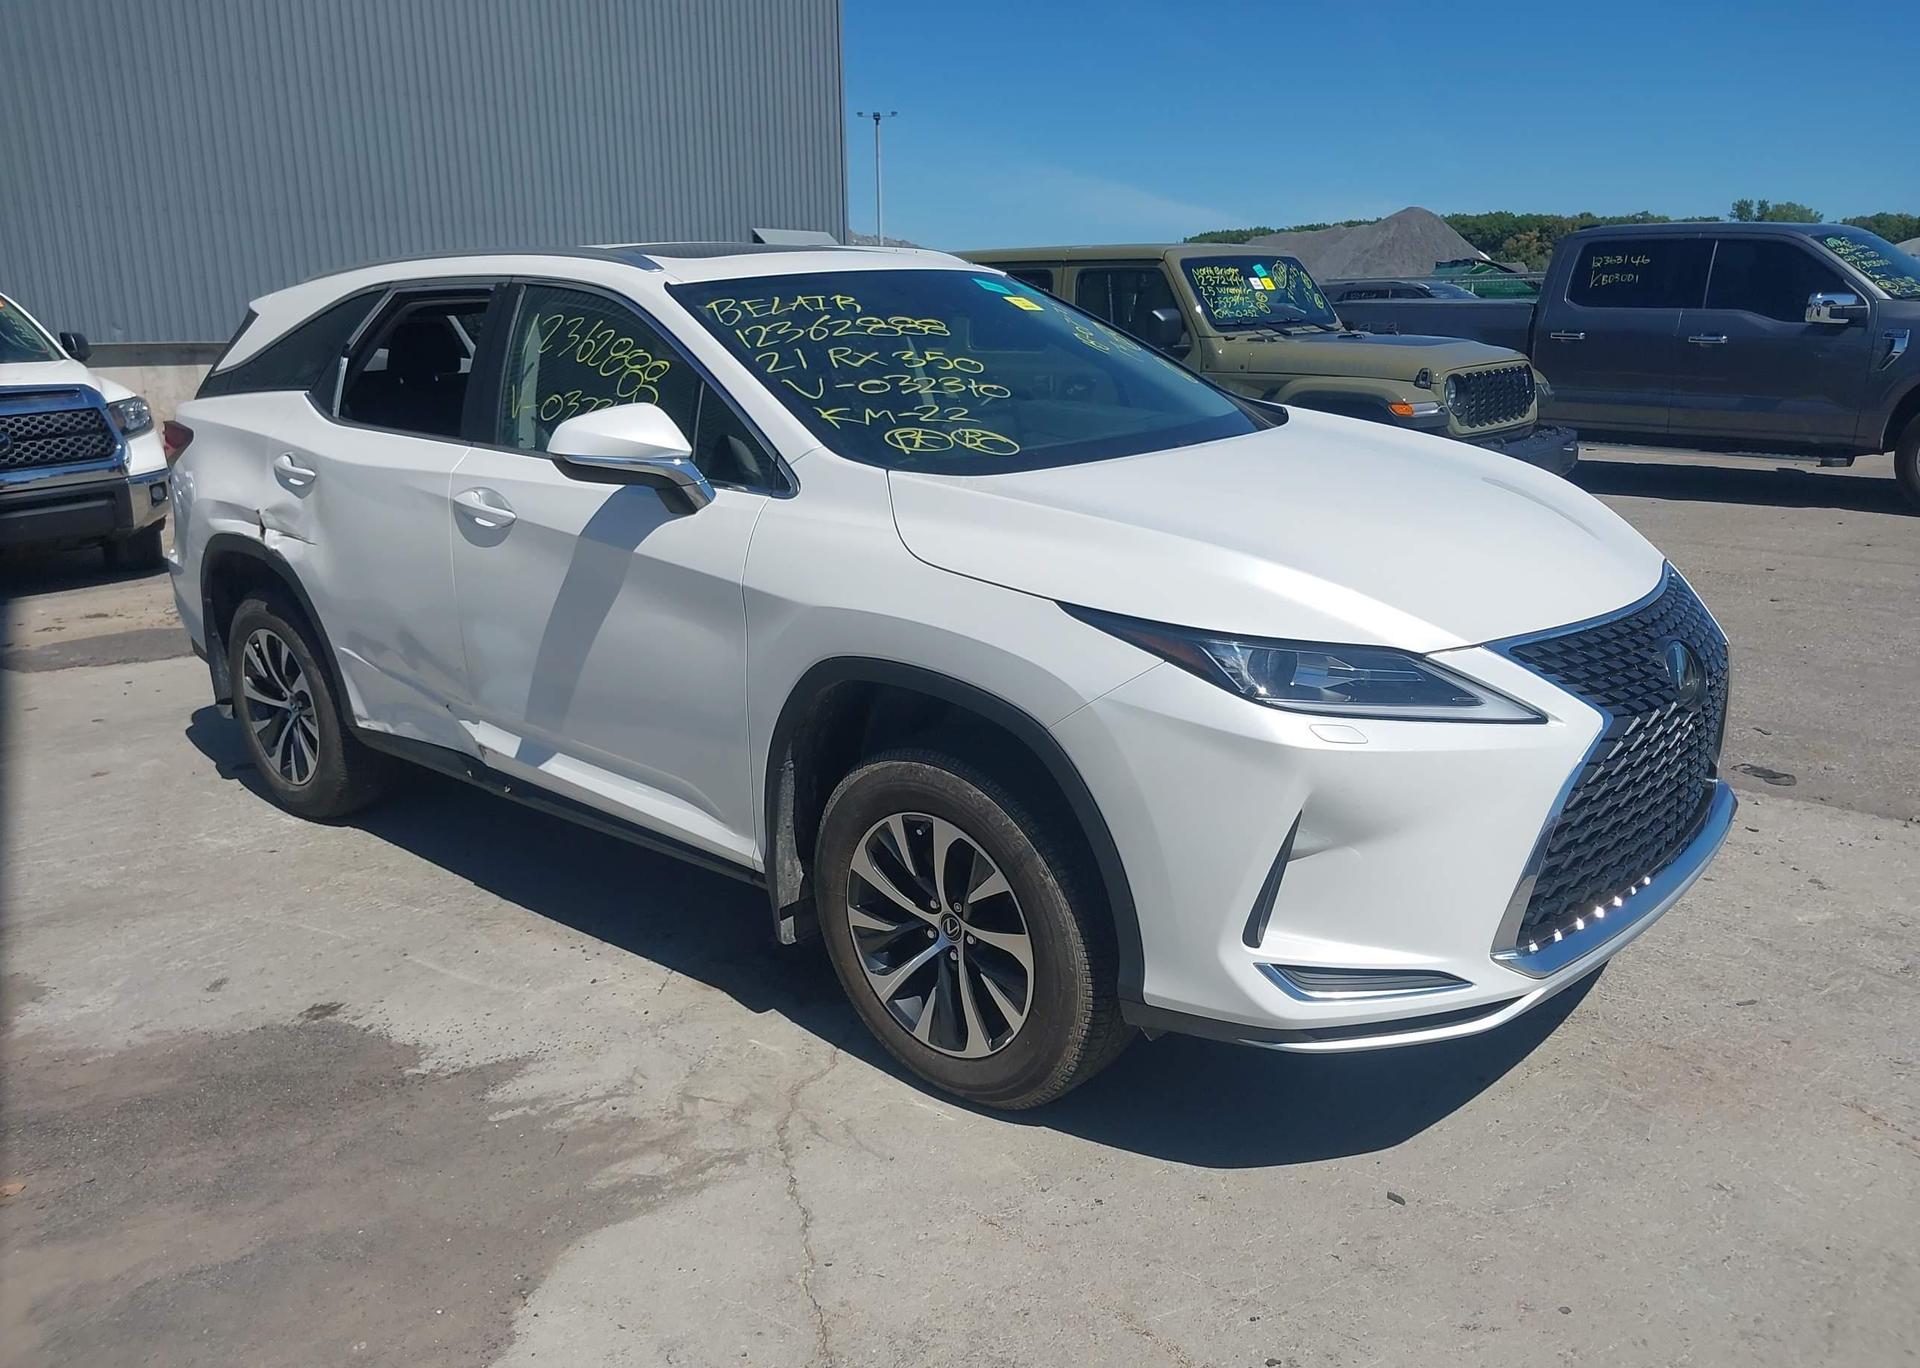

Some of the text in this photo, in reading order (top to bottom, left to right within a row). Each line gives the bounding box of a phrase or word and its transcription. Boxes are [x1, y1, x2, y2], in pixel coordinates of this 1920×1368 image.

[706, 294, 862, 326] BELAIR
[735, 314, 951, 350] 12362888
[755, 348, 808, 374] 21
[891, 350, 985, 374] 350
